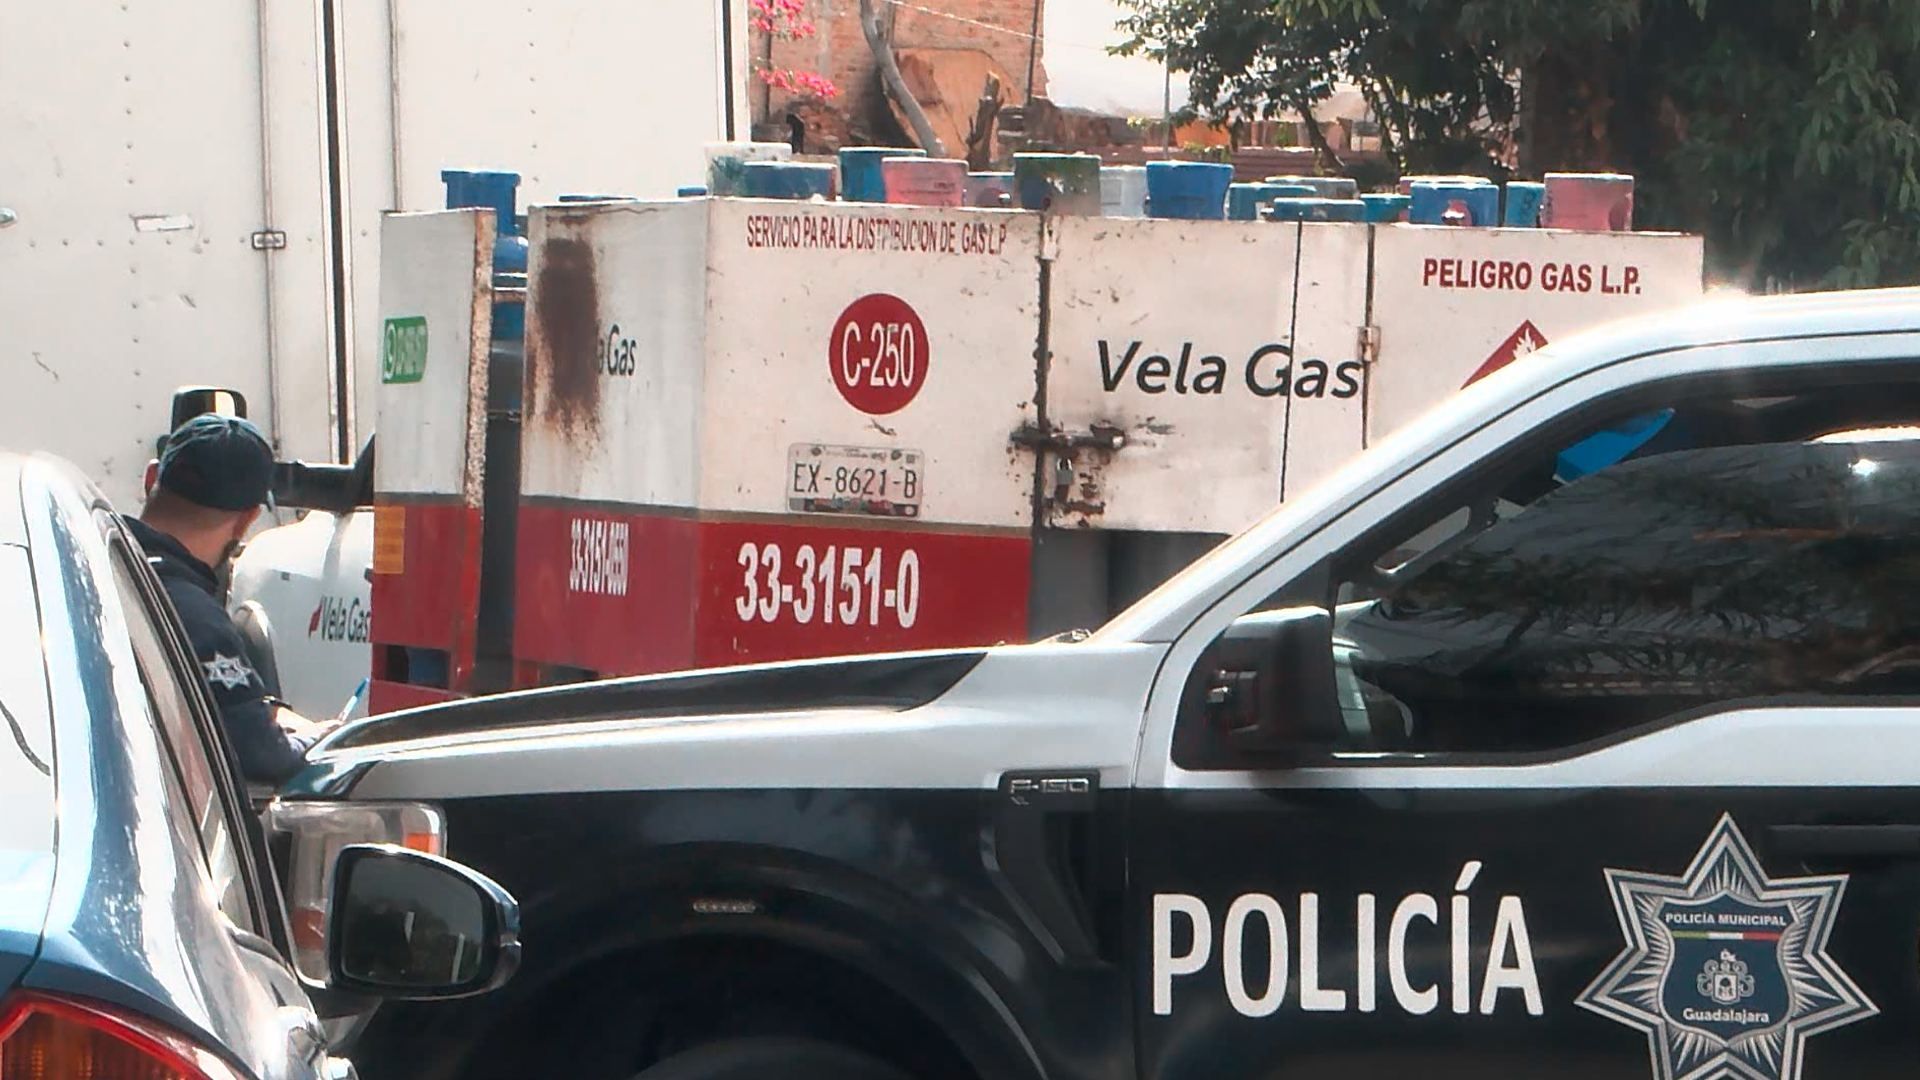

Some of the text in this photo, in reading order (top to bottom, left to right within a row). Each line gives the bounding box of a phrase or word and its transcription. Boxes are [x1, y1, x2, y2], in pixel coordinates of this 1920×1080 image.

[747, 215, 801, 248] SERVICIO
[939, 221, 956, 253] DE
[961, 222, 986, 255] GAS
[1423, 258, 1641, 294] PELIGRO GAS L.P.
[607, 325, 636, 376] Gas
[842, 321, 915, 388] C-250
[1098, 340, 1363, 398] Vela Gas
[794, 462, 917, 498] EX-8621-B
[735, 542, 919, 628] 33-3151-0
[321, 596, 371, 643] Vela Gas
[1153, 860, 1544, 1018] POLICÍA
[1665, 912, 1787, 926] POLICÍA MUNICIPAL
[1682, 1007, 1770, 1025] Guadalajara
